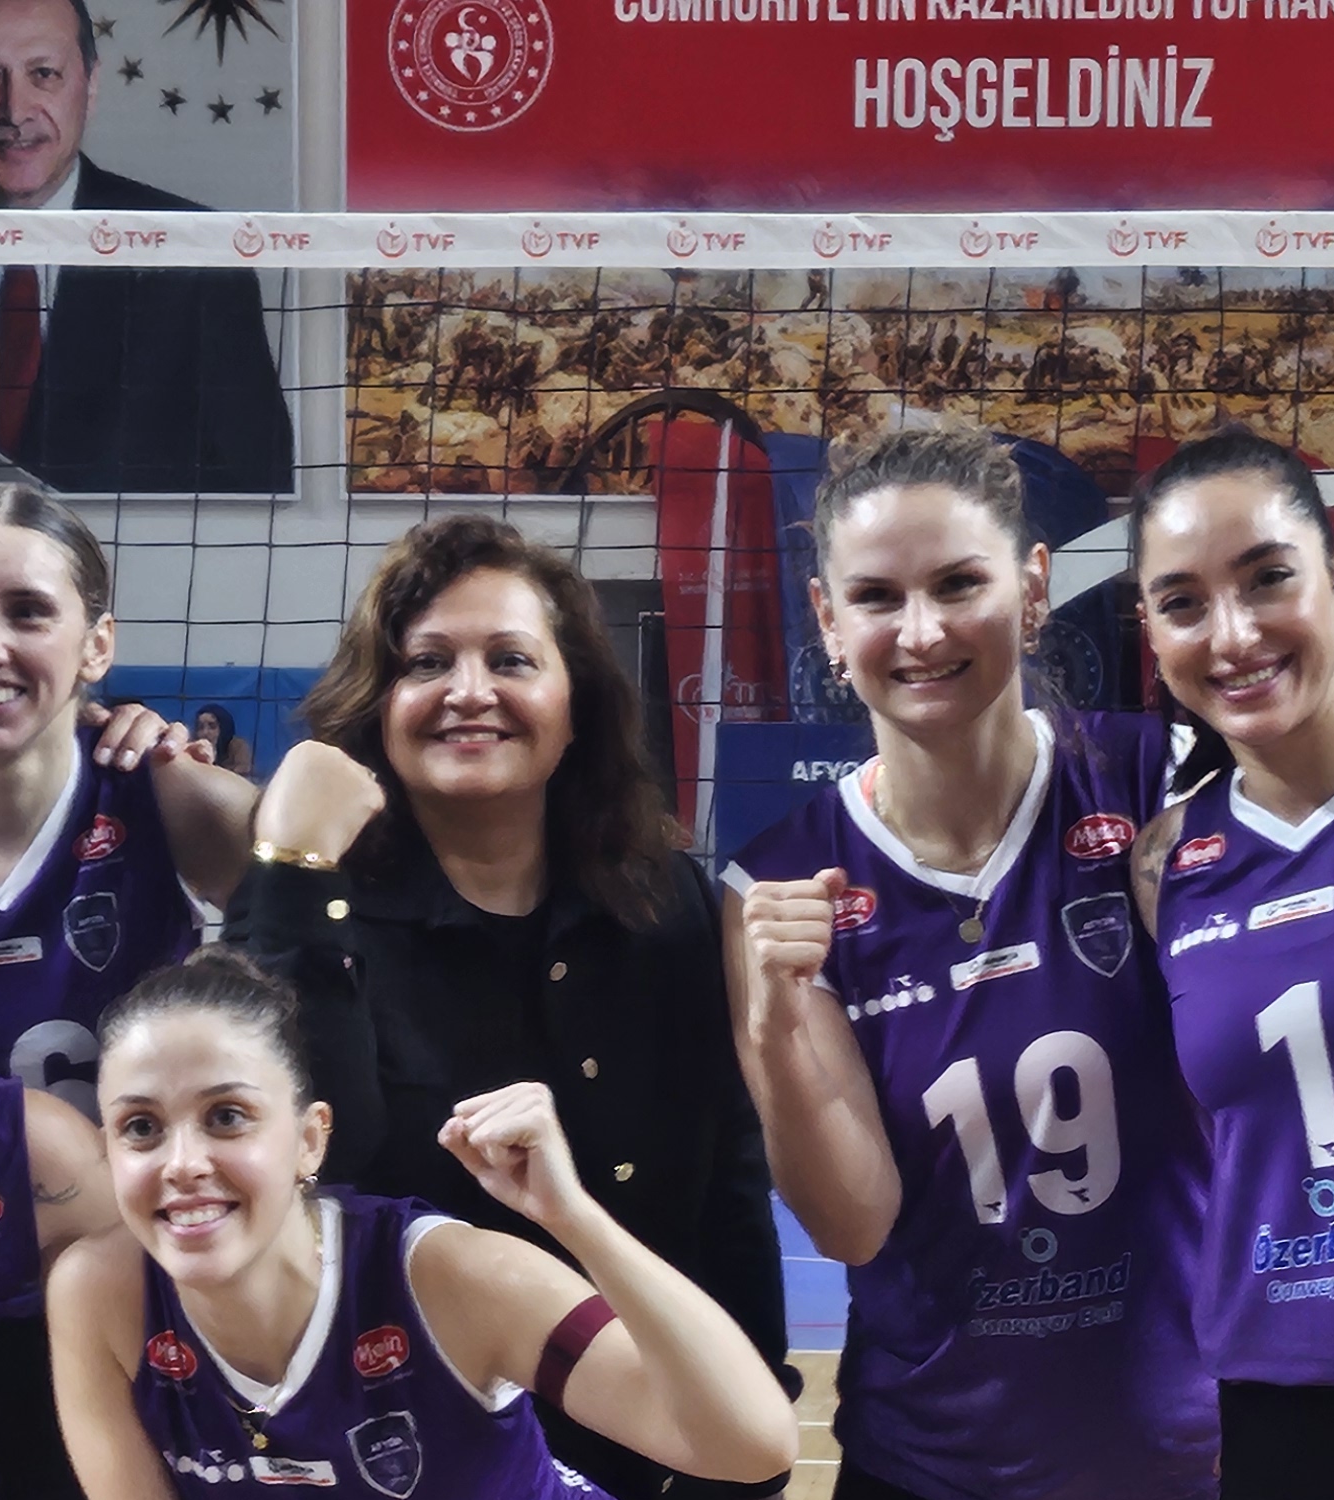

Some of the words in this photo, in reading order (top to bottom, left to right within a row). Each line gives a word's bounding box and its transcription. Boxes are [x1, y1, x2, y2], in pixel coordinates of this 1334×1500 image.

[854, 45, 1215, 142] HOŞGELDİNİZ
[125, 230, 166, 247] TVF
[268, 231, 310, 249] TVF
[411, 232, 455, 251] TVF
[556, 231, 600, 251] TVF
[702, 232, 746, 251] TVF
[848, 232, 893, 251] TVF
[996, 232, 1039, 250] TVF
[1143, 231, 1188, 249] TVF
[922, 1029, 1123, 1225] 19
